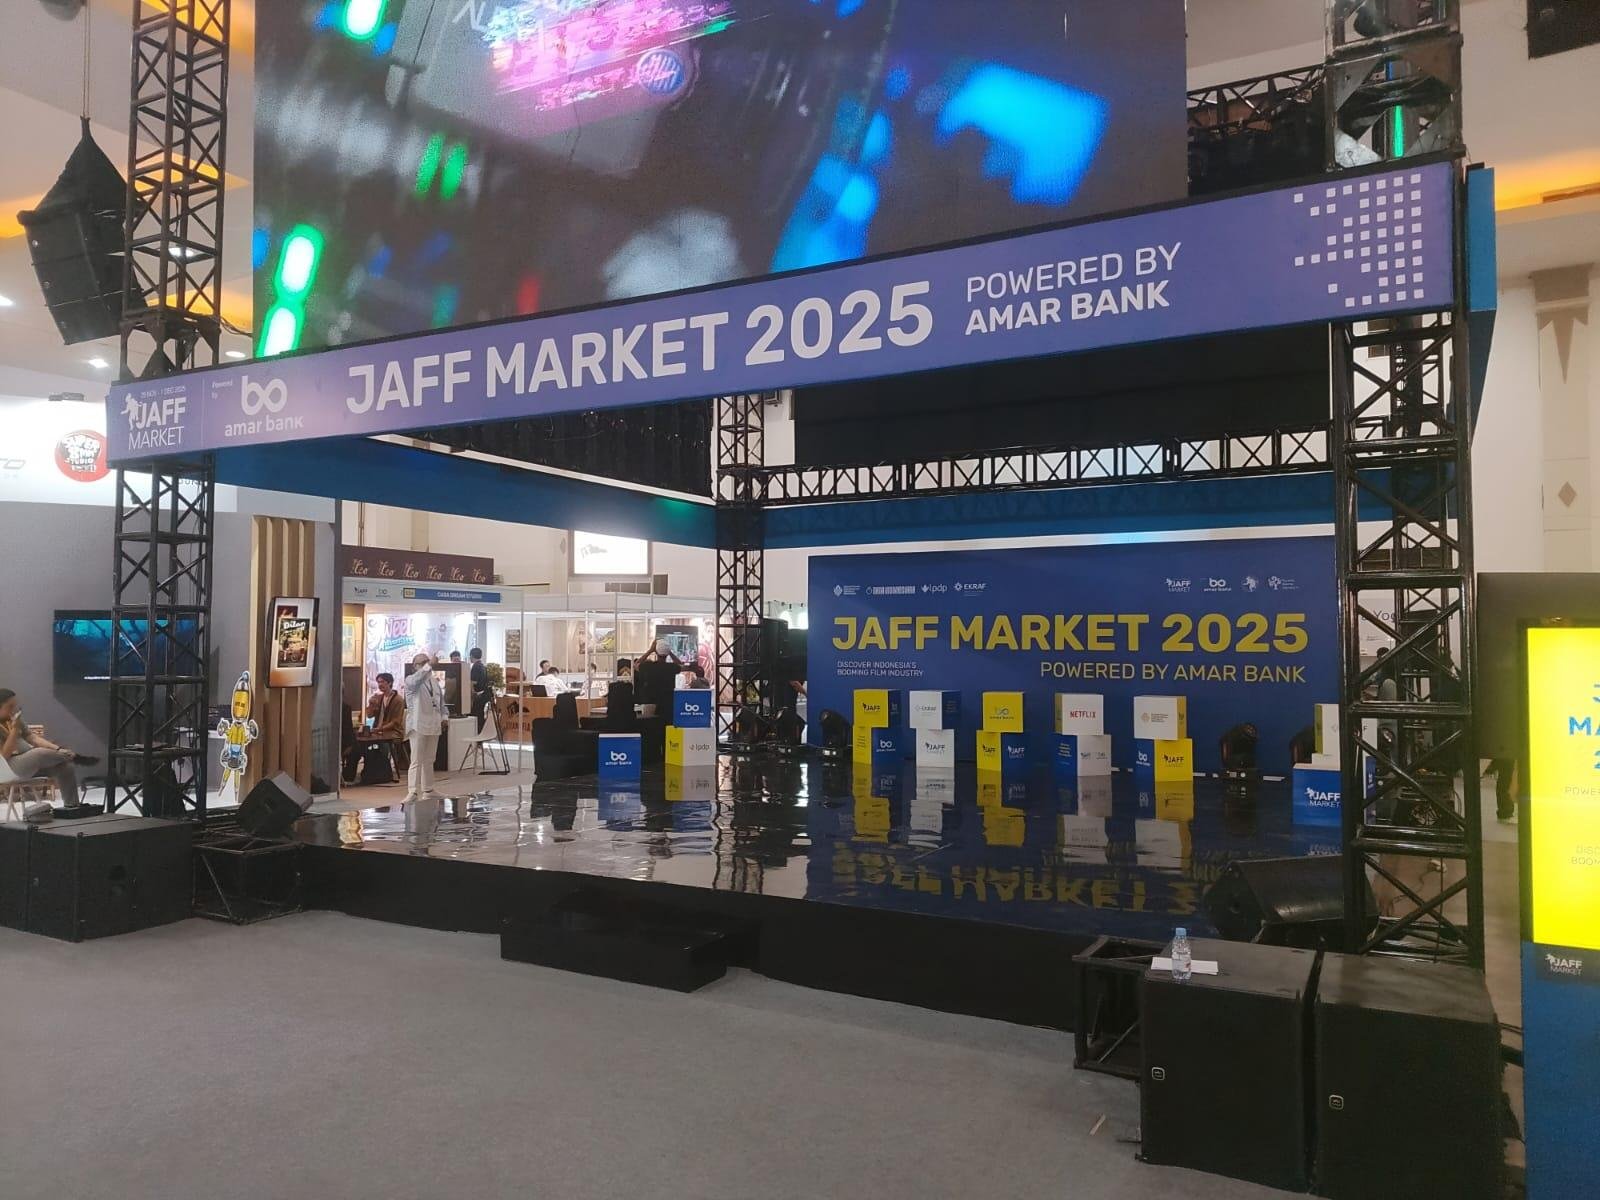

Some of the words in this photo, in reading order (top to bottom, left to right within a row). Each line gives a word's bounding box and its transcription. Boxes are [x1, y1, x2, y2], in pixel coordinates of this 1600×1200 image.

[968, 253, 1123, 302] POWERED
[1135, 242, 1181, 276] BY
[965, 297, 1061, 335] AMAR
[1071, 280, 1170, 320] BANK
[346, 350, 472, 414] JAFF
[486, 312, 729, 398] MARKET
[745, 281, 933, 366] 2025
[136, 396, 187, 430] JAFF
[224, 421, 262, 437] amar
[128, 426, 185, 450] MARKET
[964, 582, 987, 590] EKRAF
[832, 616, 939, 650] JAFF
[950, 614, 1149, 652] MARKET
[1161, 613, 1309, 653] 2025
[836, 660, 872, 668] DISCOVER
[873, 661, 917, 669] INDONESIA'S
[836, 668, 869, 676] BOOMING
[887, 669, 924, 677] INDUSTRY
[1041, 661, 1135, 680] POWERED
[1142, 663, 1168, 681] BY
[1174, 664, 1236, 682] AMAR
[1244, 665, 1306, 684] BANK
[1070, 710, 1096, 718] NETFLIX
[695, 743, 710, 752] lpdp
[1313, 791, 1341, 802] JAFF
[1309, 800, 1341, 808] MARKET
[1554, 958, 1583, 969] JAFF
[1550, 966, 1582, 976] MARKET
